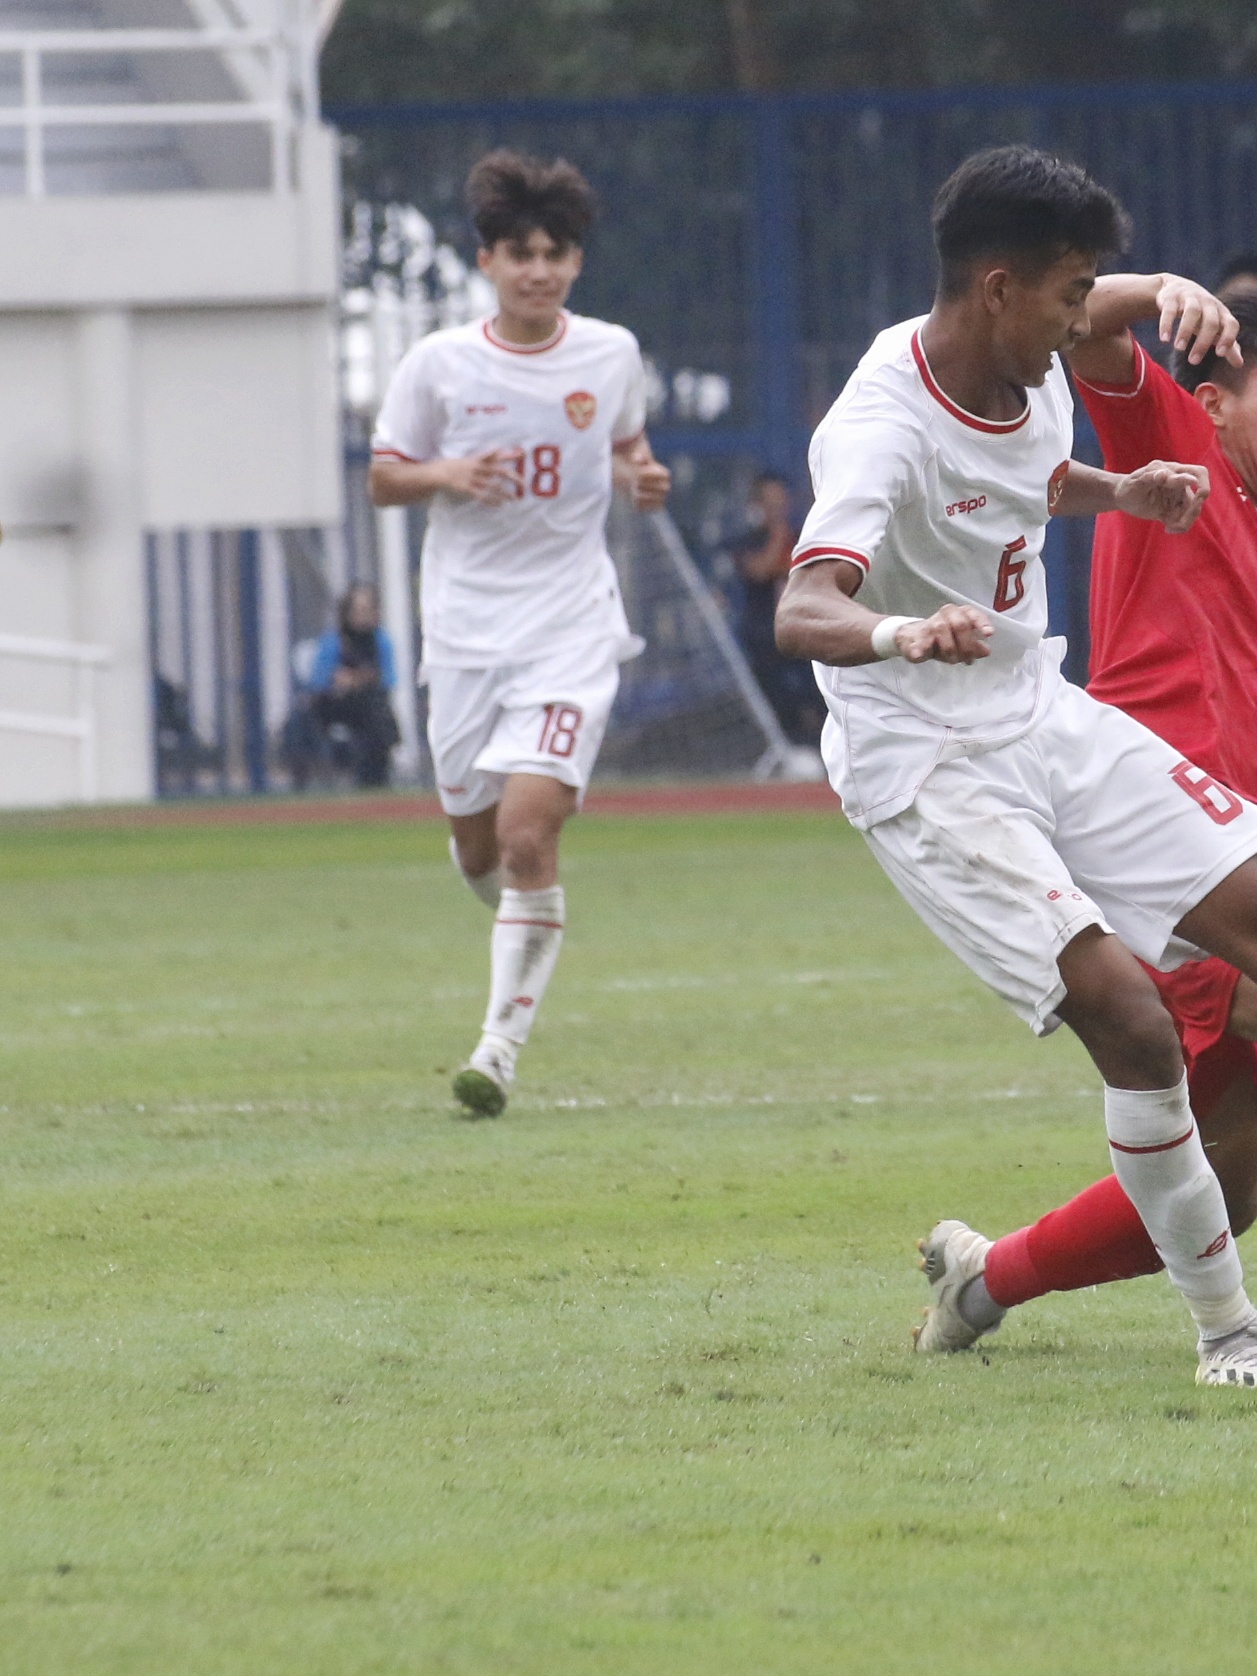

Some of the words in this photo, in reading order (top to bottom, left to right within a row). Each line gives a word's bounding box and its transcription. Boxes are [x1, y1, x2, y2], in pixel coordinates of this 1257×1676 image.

[511, 444, 560, 498] 18
[945, 494, 987, 517] erspo
[993, 534, 1027, 613] 6
[537, 703, 583, 758] 18
[1167, 760, 1244, 826] 6
